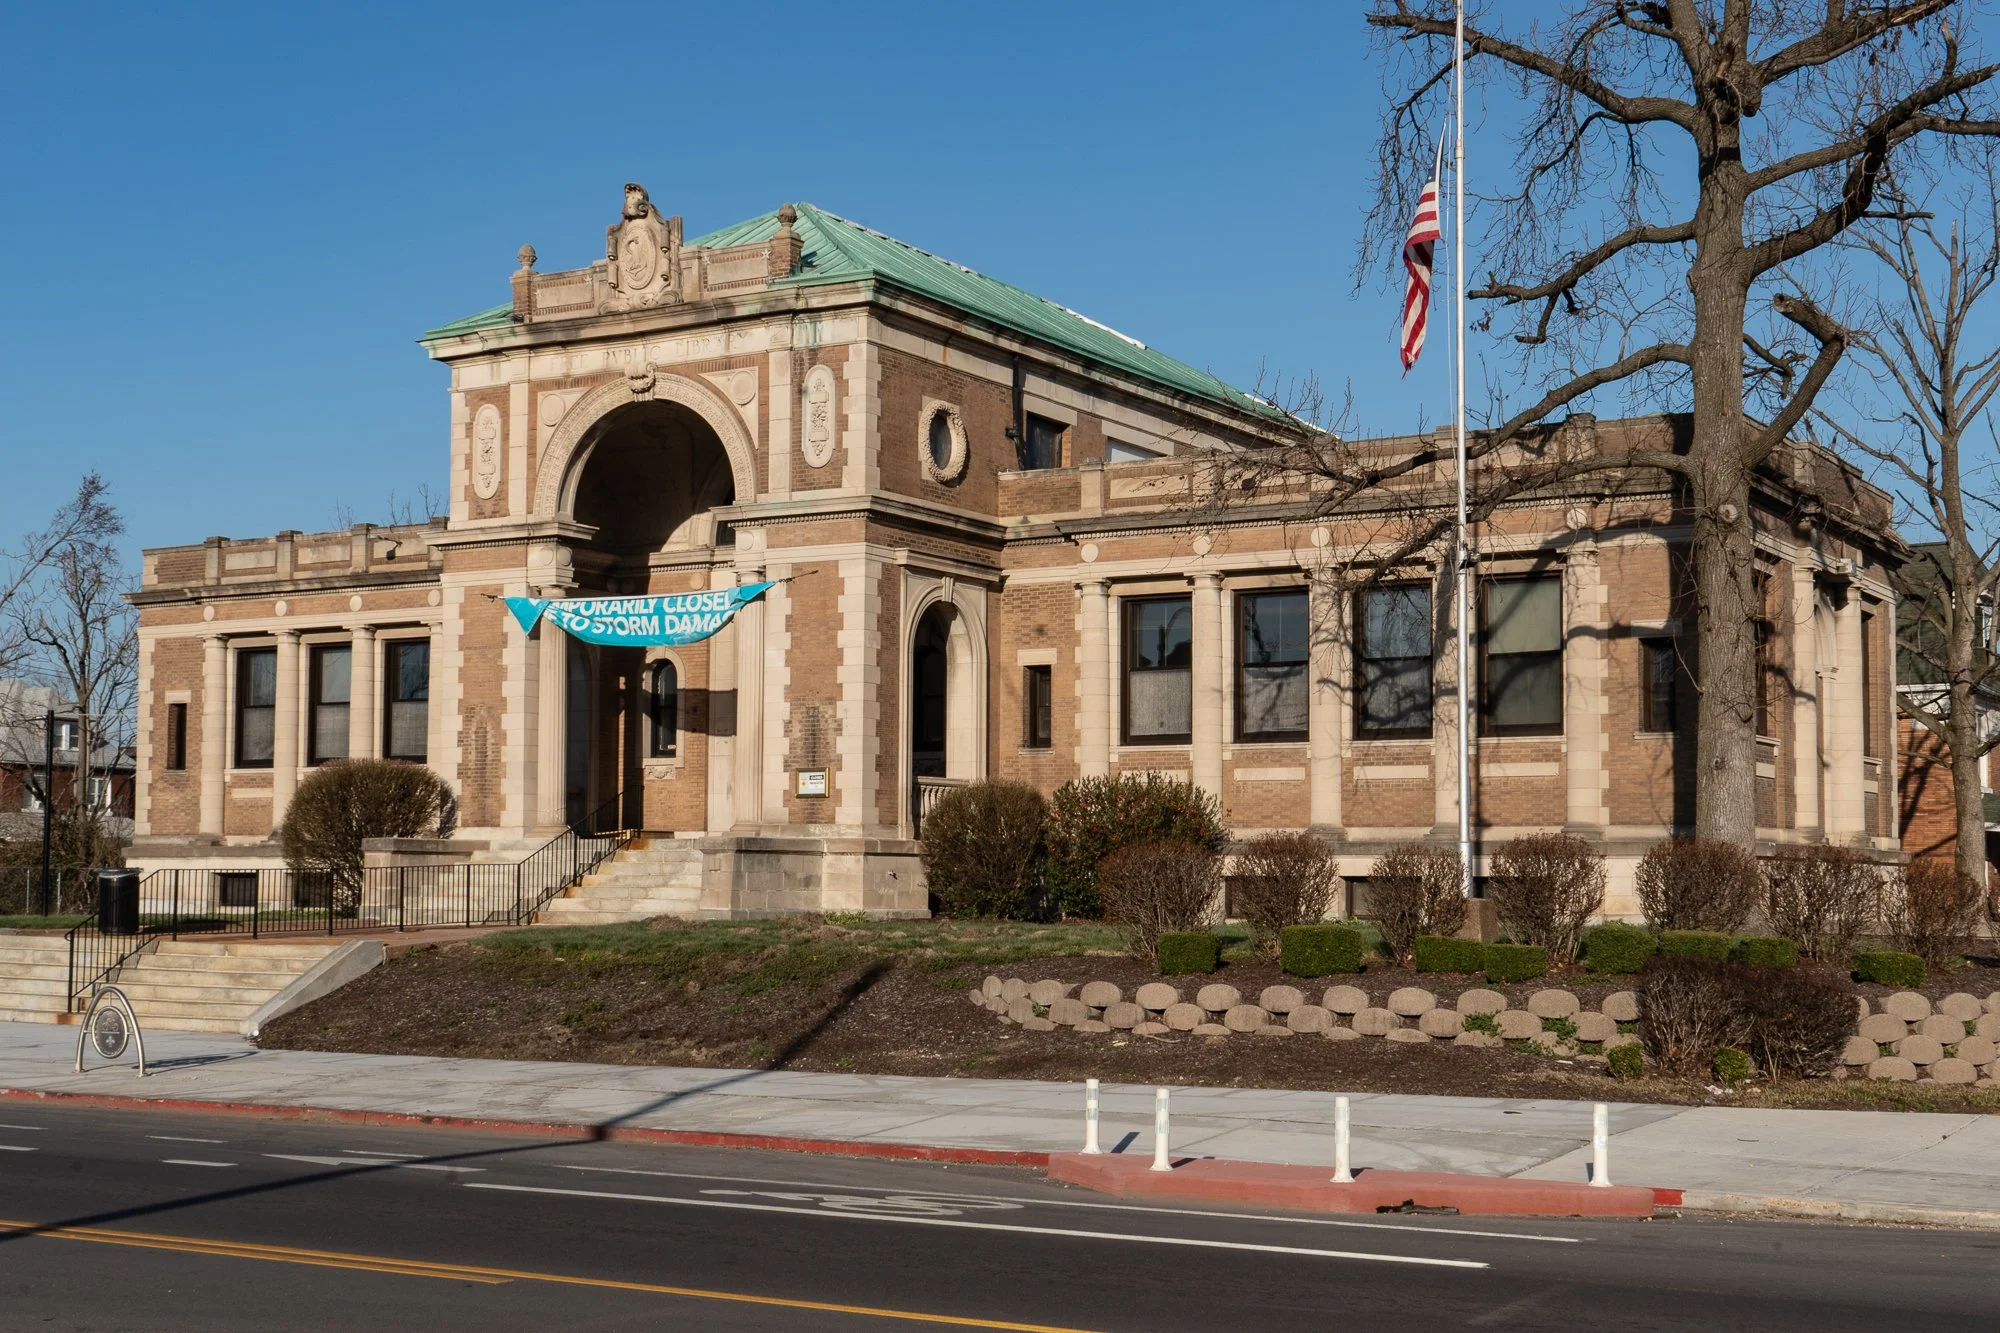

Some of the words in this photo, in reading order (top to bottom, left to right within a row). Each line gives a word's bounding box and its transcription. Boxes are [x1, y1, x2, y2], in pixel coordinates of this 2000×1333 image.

[675, 332, 753, 357] LIBRARY
[553, 597, 658, 616] MPORARILY
[561, 612, 590, 631] TO
[591, 615, 660, 636] STORM
